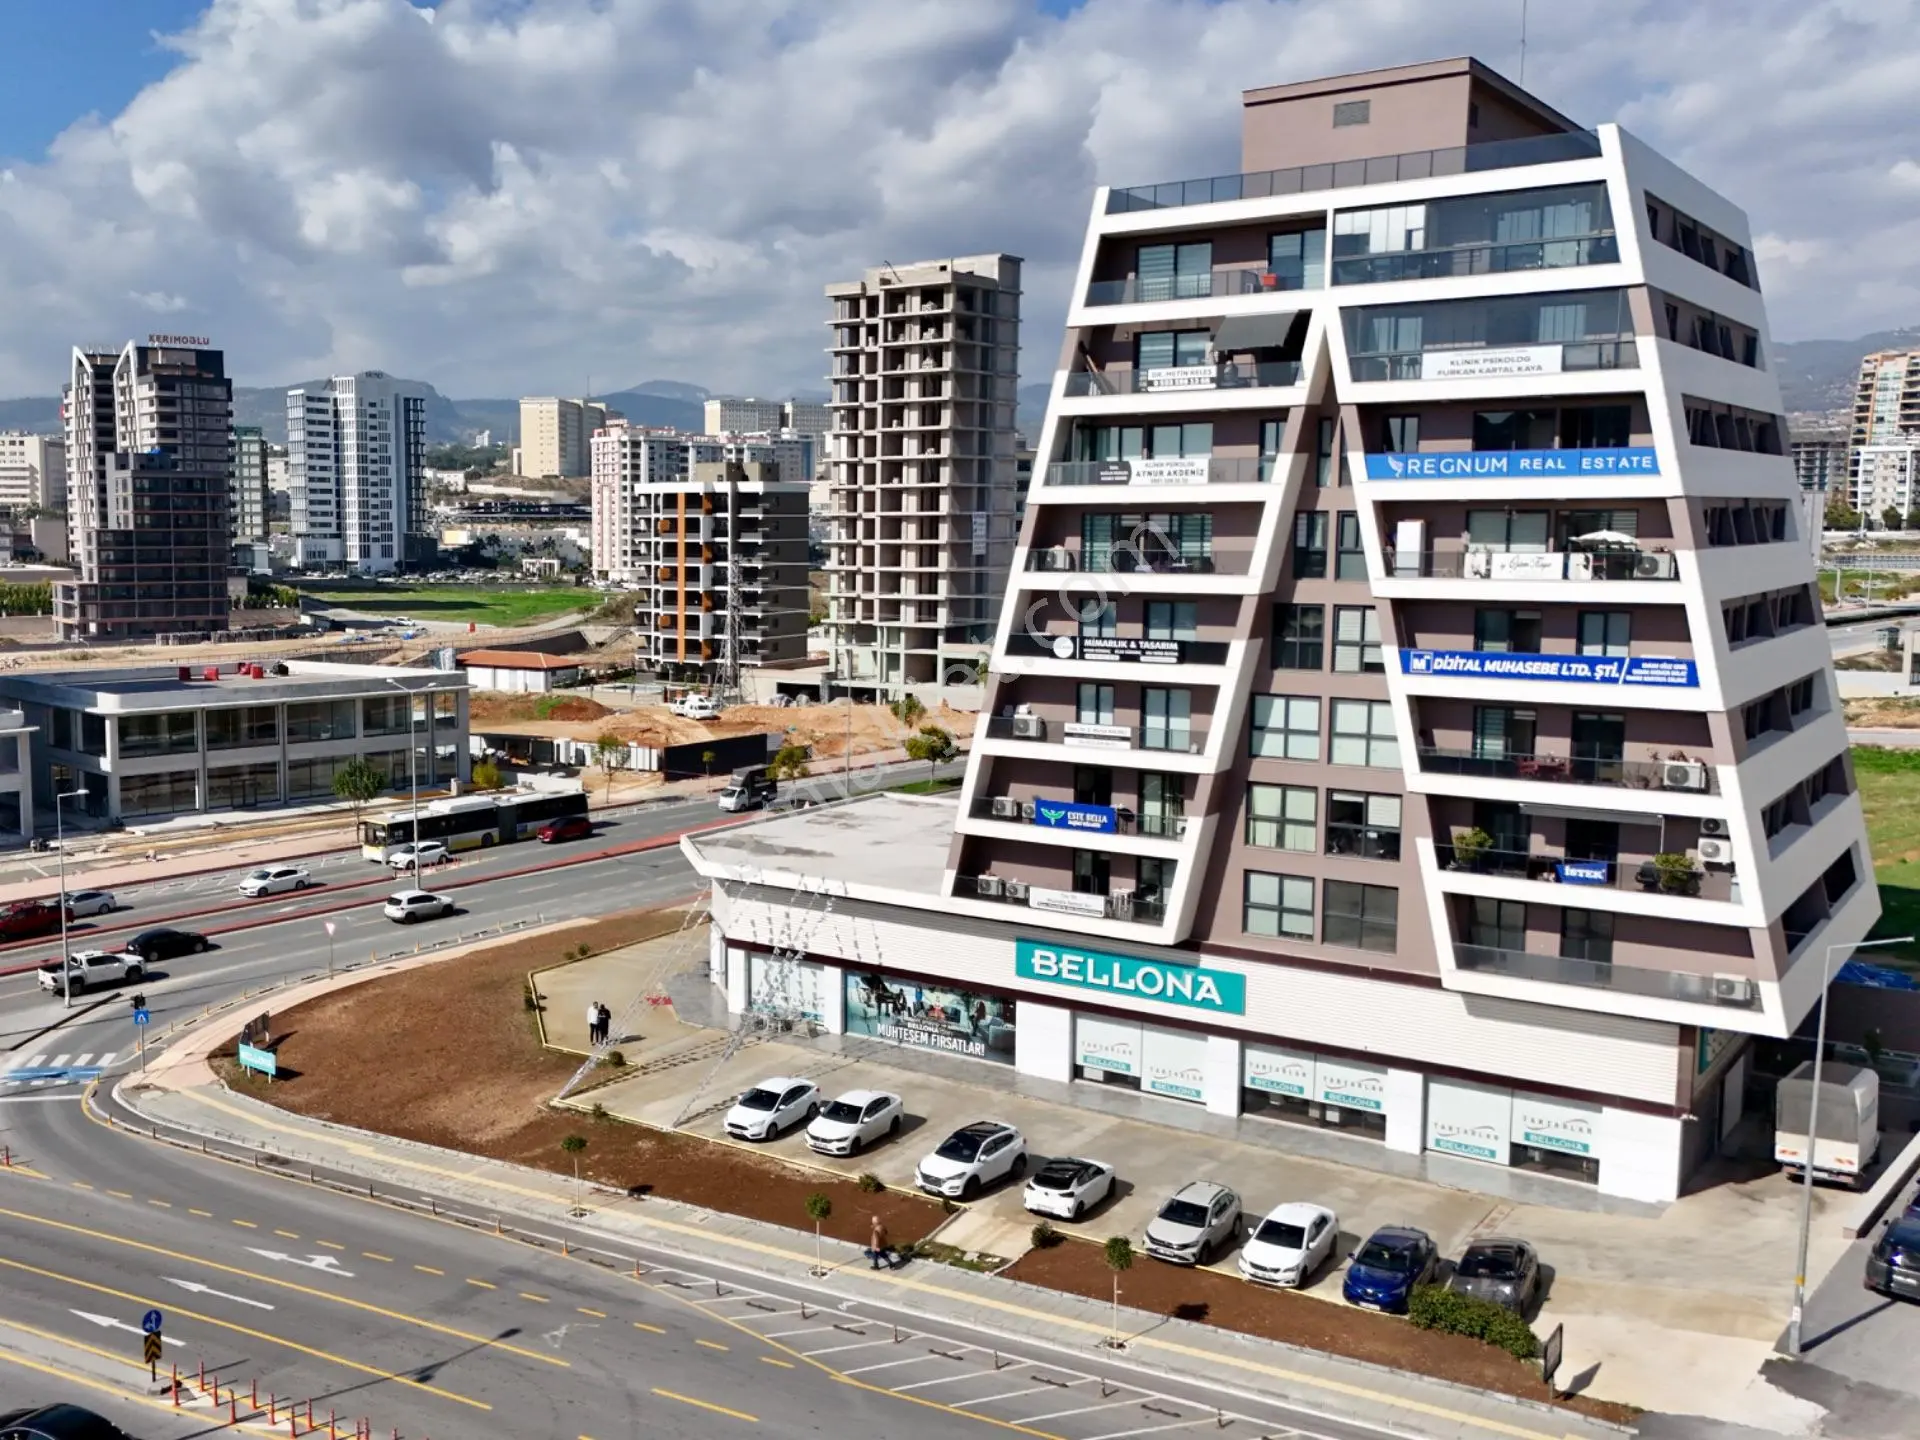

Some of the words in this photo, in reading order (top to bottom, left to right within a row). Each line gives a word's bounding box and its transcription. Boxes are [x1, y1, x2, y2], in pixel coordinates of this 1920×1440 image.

[1517, 364, 1543, 372] KAYA
[1407, 456, 1508, 474] REGNUM
[1519, 457, 1567, 470] REAL
[1581, 455, 1653, 469] ESTATE
[1129, 640, 1137, 648] &
[1483, 658, 1560, 676] MUHASEBE
[1560, 663, 1592, 677] LTD.
[1031, 949, 1223, 1006] BELLONA
[876, 1023, 929, 1045] MUHTEŞEM
